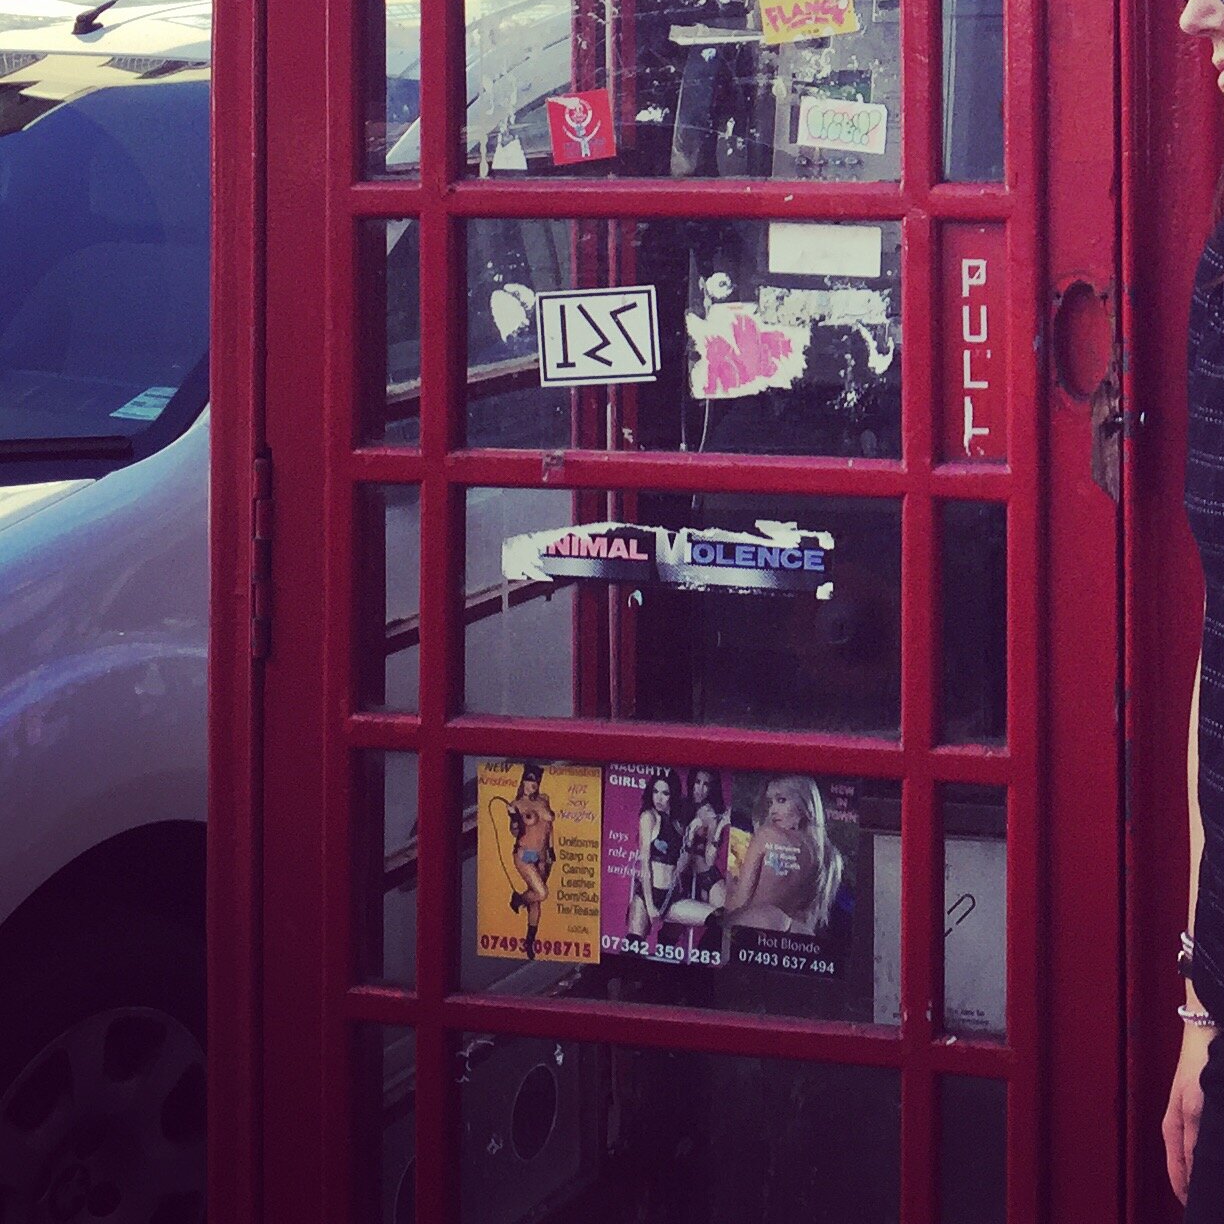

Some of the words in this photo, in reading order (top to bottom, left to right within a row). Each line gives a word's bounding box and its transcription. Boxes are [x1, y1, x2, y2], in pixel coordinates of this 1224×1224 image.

[609, 762, 672, 777] NAUGHTY
[608, 774, 647, 790] GIRLS
[608, 829, 630, 842] toys
[608, 847, 628, 859] role
[601, 934, 650, 956] 07342
[654, 943, 685, 961] 350
[689, 949, 721, 966] 283
[757, 933, 778, 949] Hot
[780, 937, 821, 955] Blonde
[738, 948, 779, 967] 07493
[782, 954, 807, 970] 637
[810, 960, 835, 974] 494
